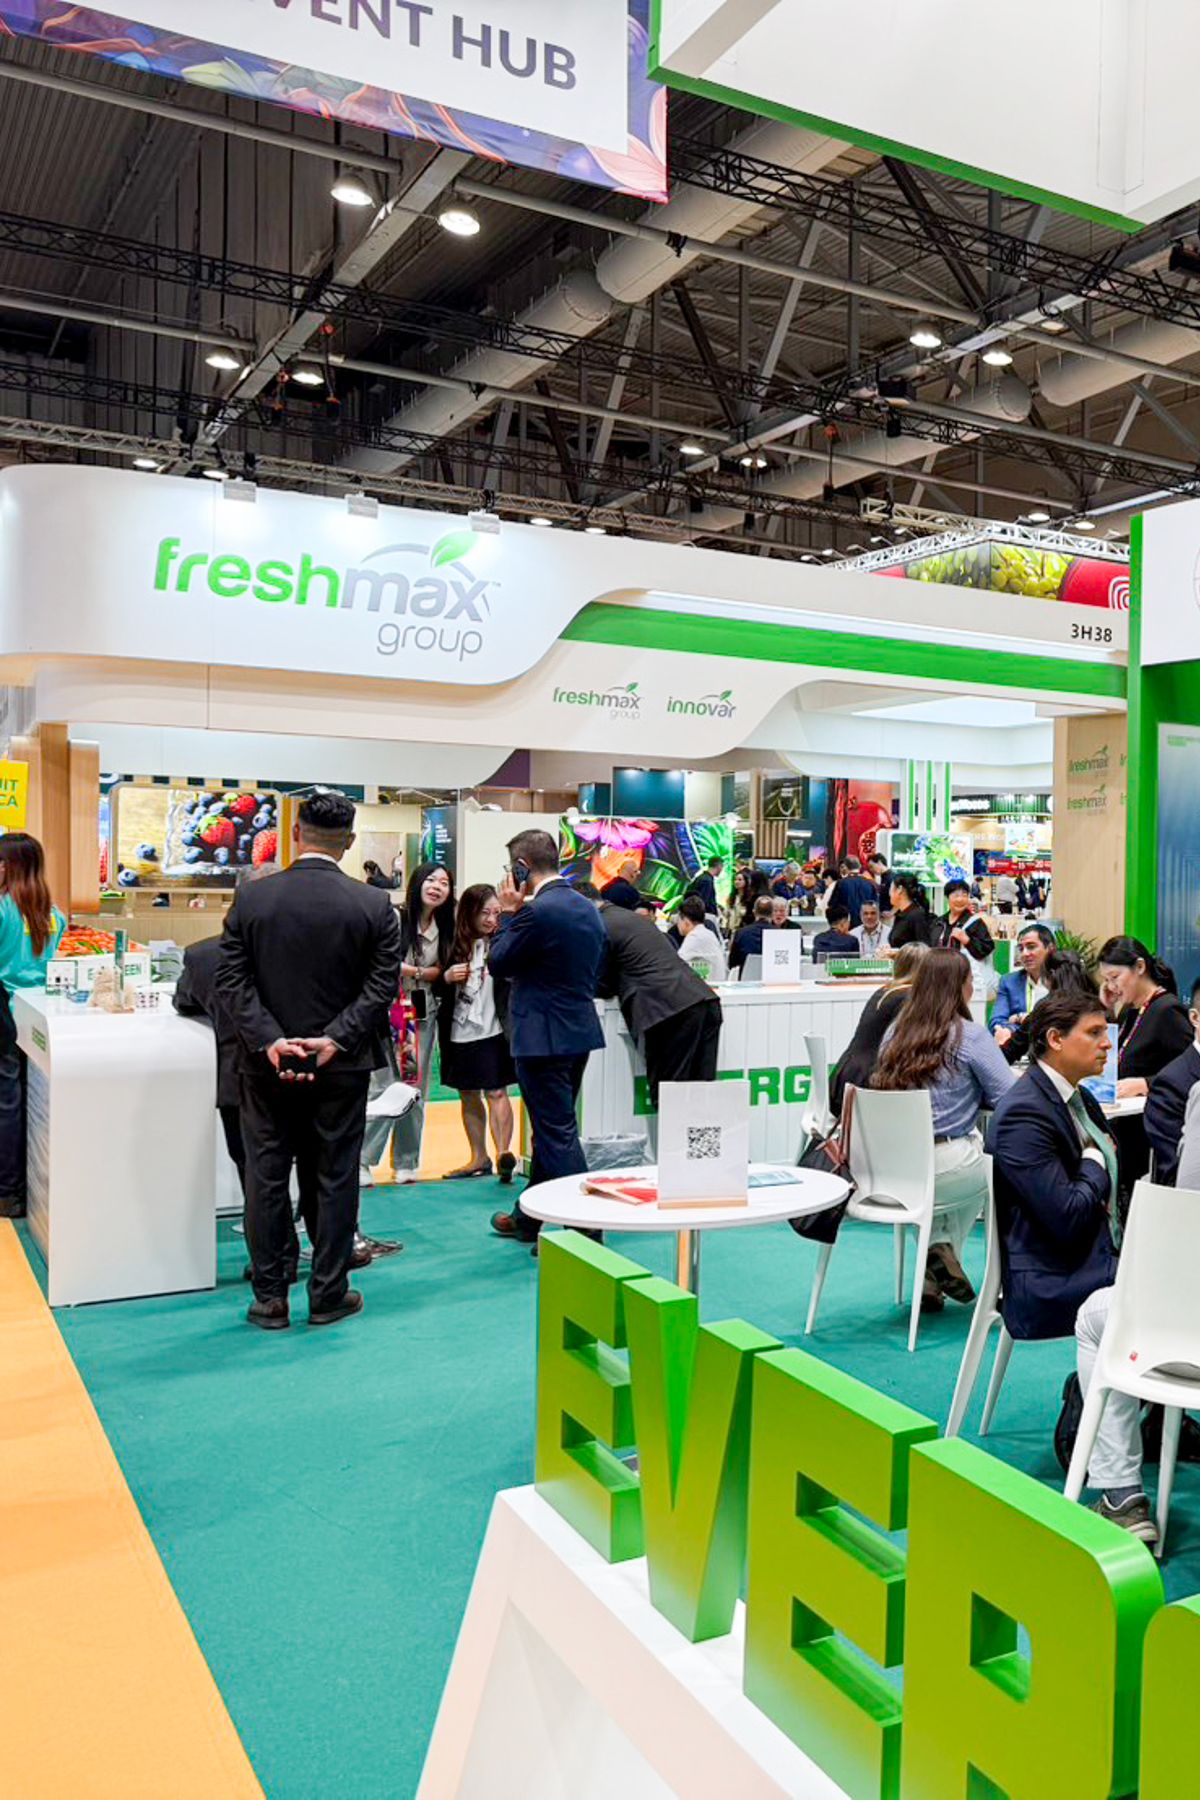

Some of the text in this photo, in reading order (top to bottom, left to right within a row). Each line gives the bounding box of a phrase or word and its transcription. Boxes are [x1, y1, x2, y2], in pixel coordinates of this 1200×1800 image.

[452, 14, 577, 90] HUB
[154, 536, 490, 622] freshmax
[377, 622, 483, 662] group
[1071, 623, 1112, 642] 3H38
[553, 687, 641, 710] freshmax
[667, 695, 737, 718] innovar
[609, 708, 641, 720] group
